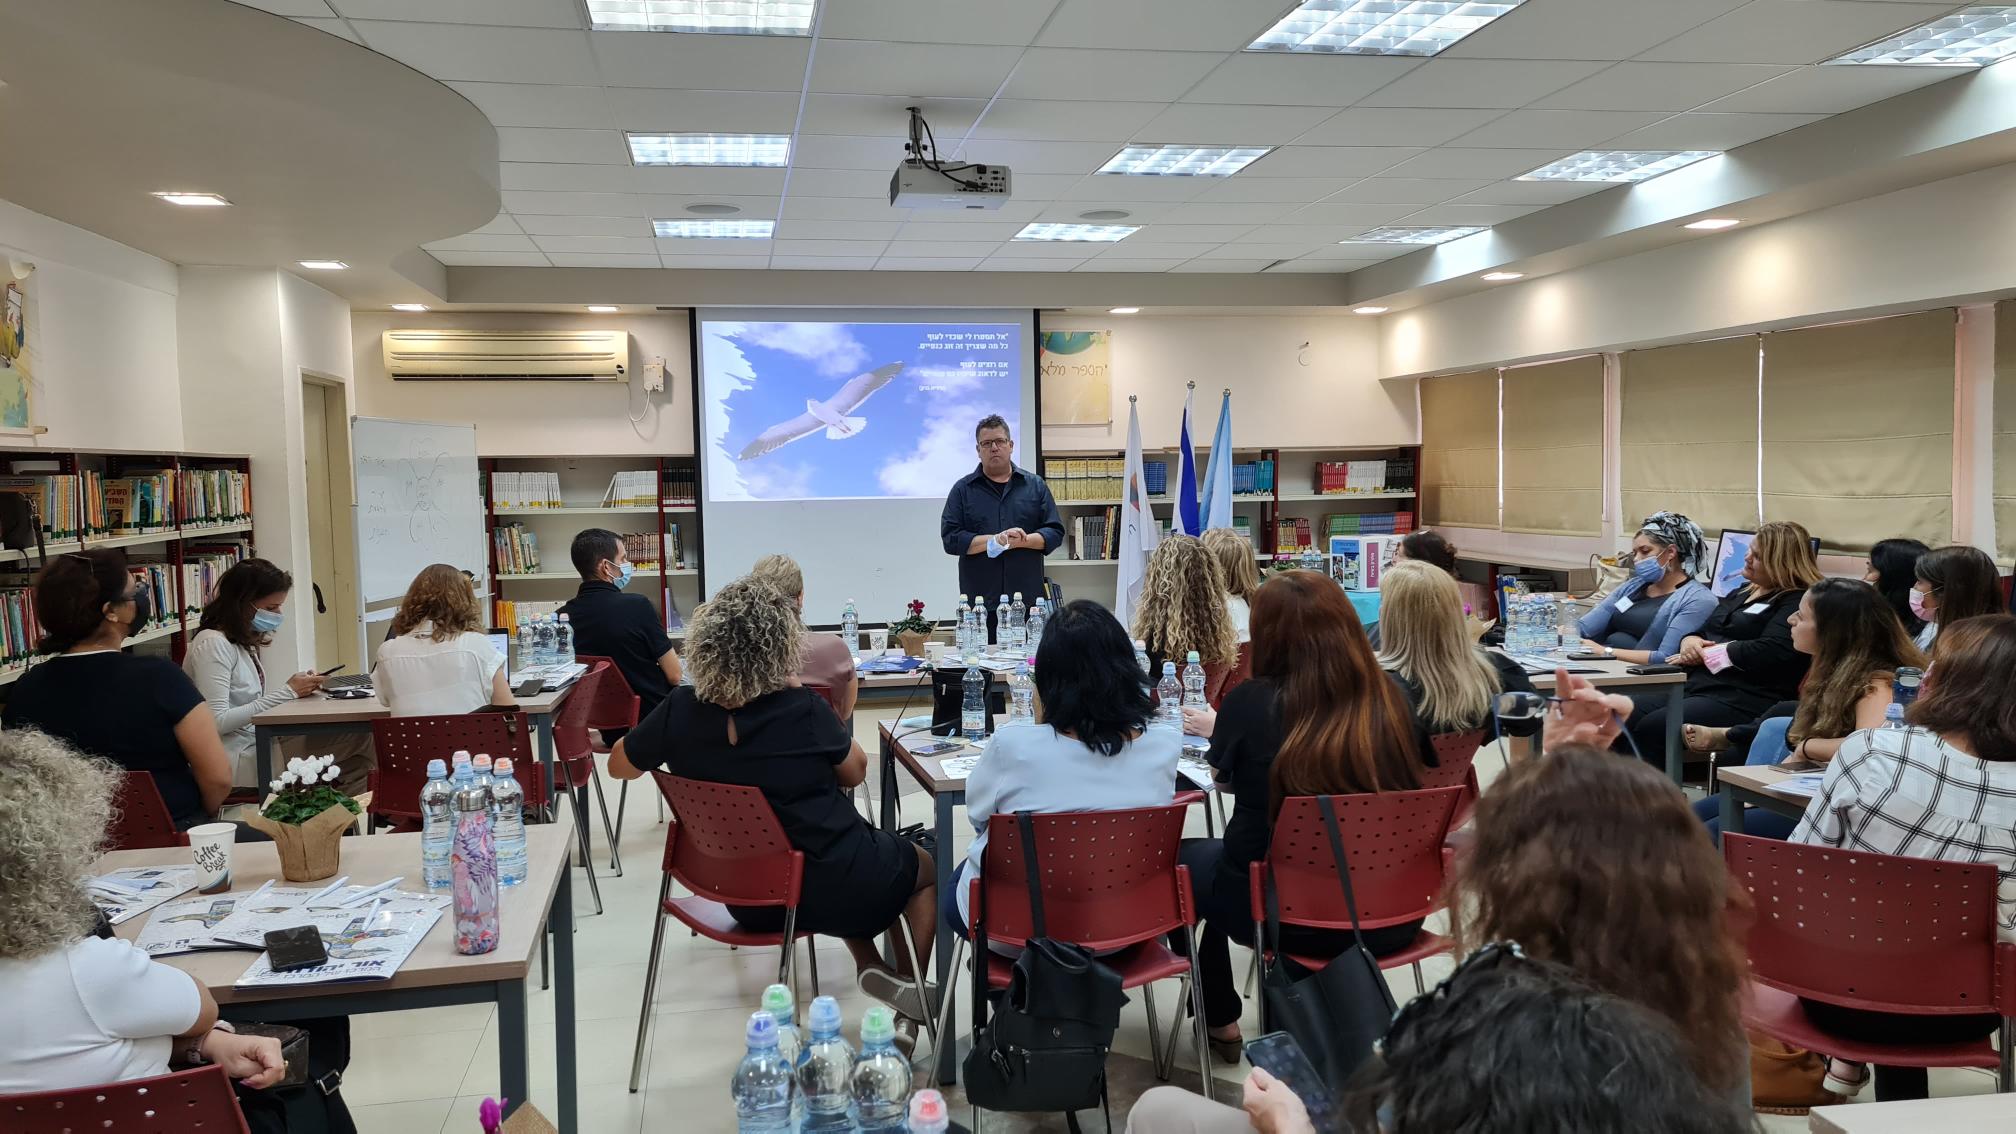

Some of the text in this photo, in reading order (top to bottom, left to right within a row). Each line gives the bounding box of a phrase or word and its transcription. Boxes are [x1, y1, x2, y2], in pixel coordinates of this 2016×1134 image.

[927, 332, 944, 341] לעוף
[965, 332, 973, 340] לי
[965, 343, 987, 351] שצריך
[999, 342, 1008, 350] כל
[960, 360, 977, 369] לעוף
[193, 842, 221, 865] Coffee
[202, 851, 227, 873] Break
[352, 960, 387, 968] אור
